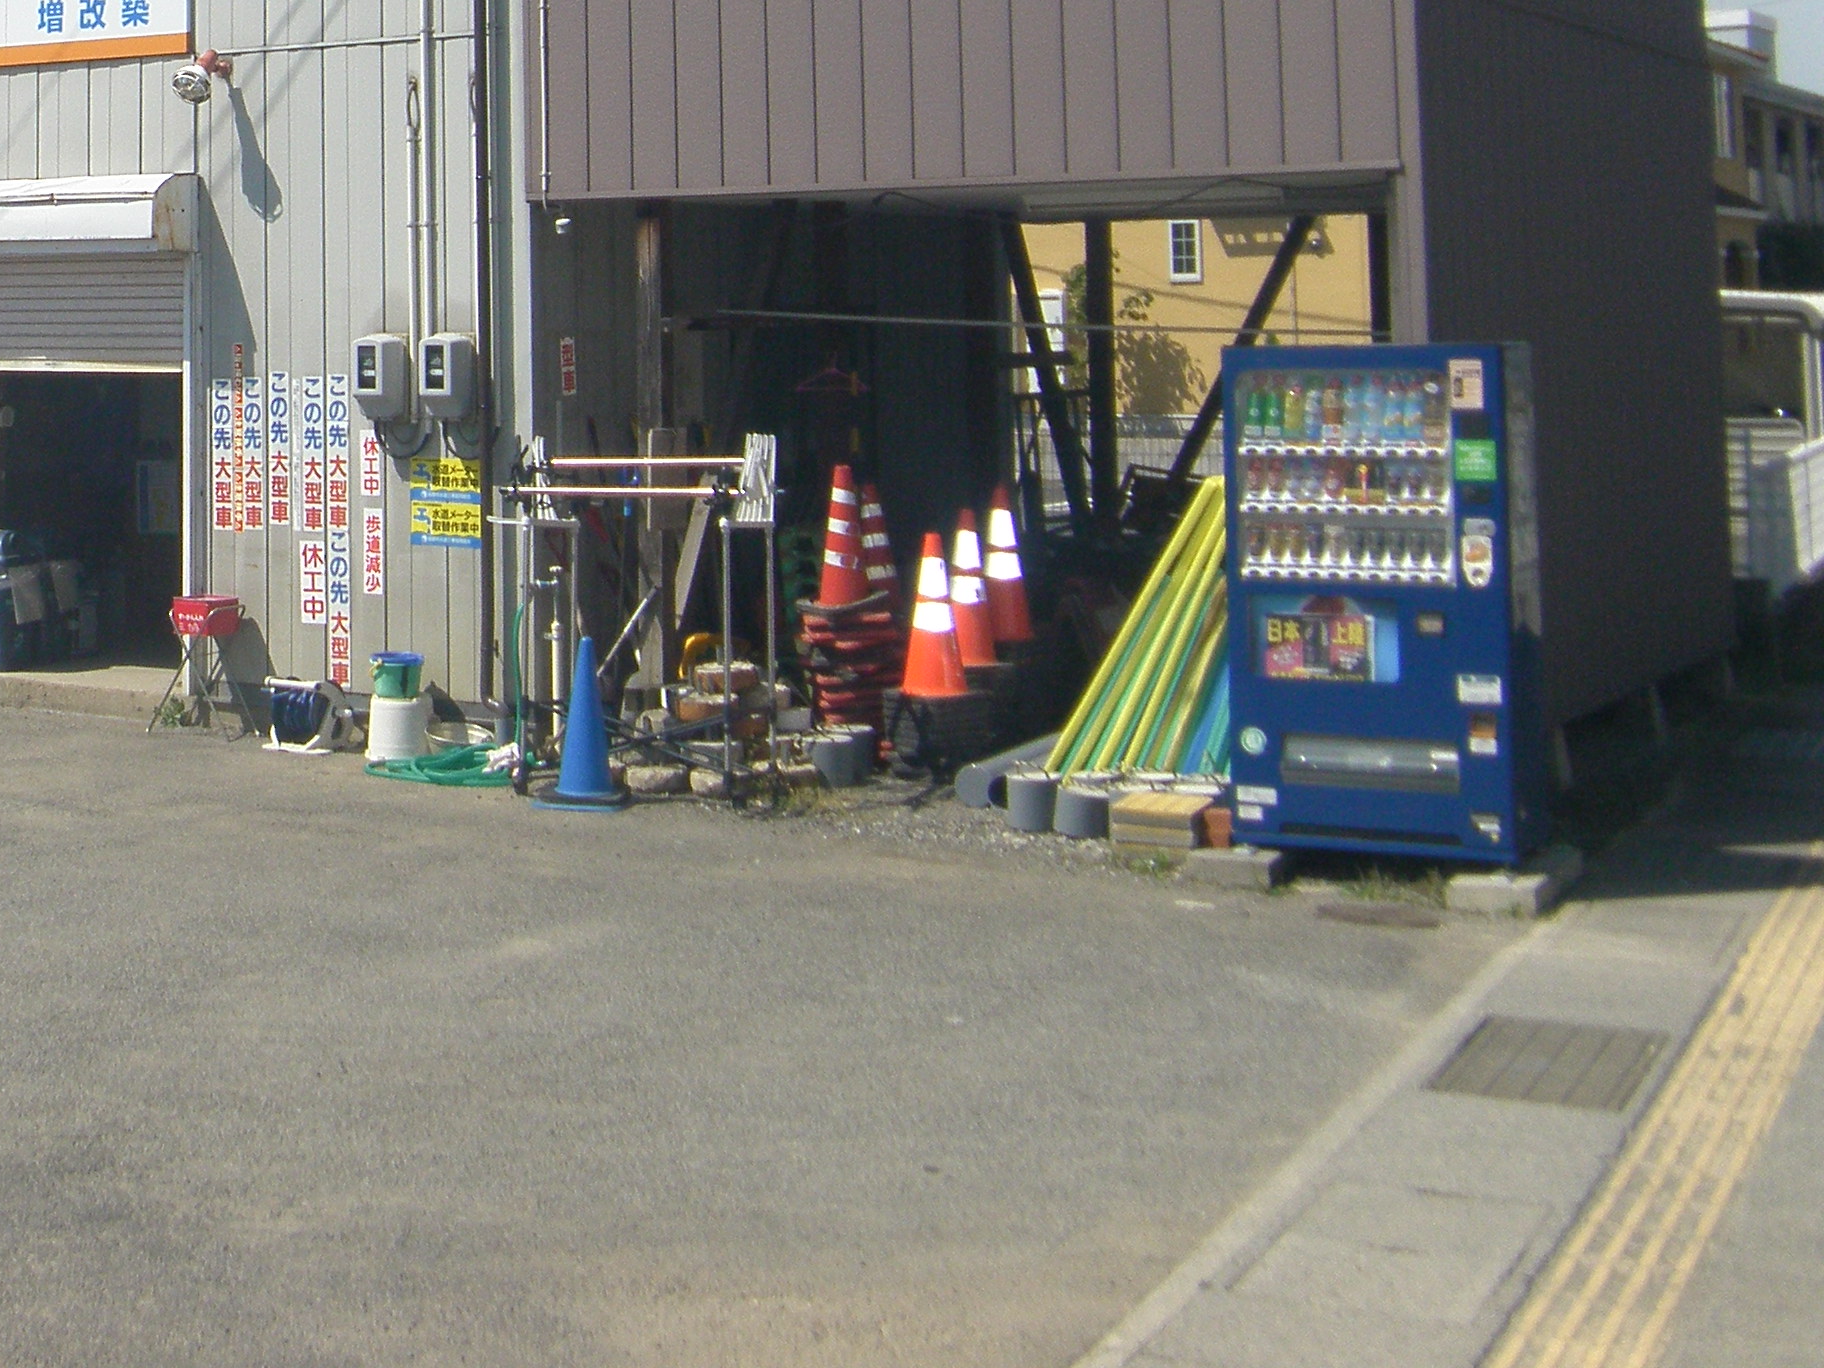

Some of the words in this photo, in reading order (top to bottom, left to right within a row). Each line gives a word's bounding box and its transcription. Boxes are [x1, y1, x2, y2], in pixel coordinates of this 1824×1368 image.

[214, 380, 231, 450] この先
[244, 379, 261, 449] この先
[270, 372, 288, 443] この先
[304, 378, 322, 450] この先
[329, 375, 347, 448] この先
[214, 457, 232, 528] 大型車
[244, 456, 262, 528] 大型車
[271, 451, 289, 523] 大型車
[304, 457, 322, 529] 大型車
[329, 455, 347, 528] 大型車
[363, 436, 379, 495] 休工中
[432, 509, 479, 520] 水道メーター
[302, 544, 324, 620] 休工中
[330, 532, 348, 604] この先
[365, 514, 381, 592] 歩道減少
[331, 611, 349, 685] 大型車
